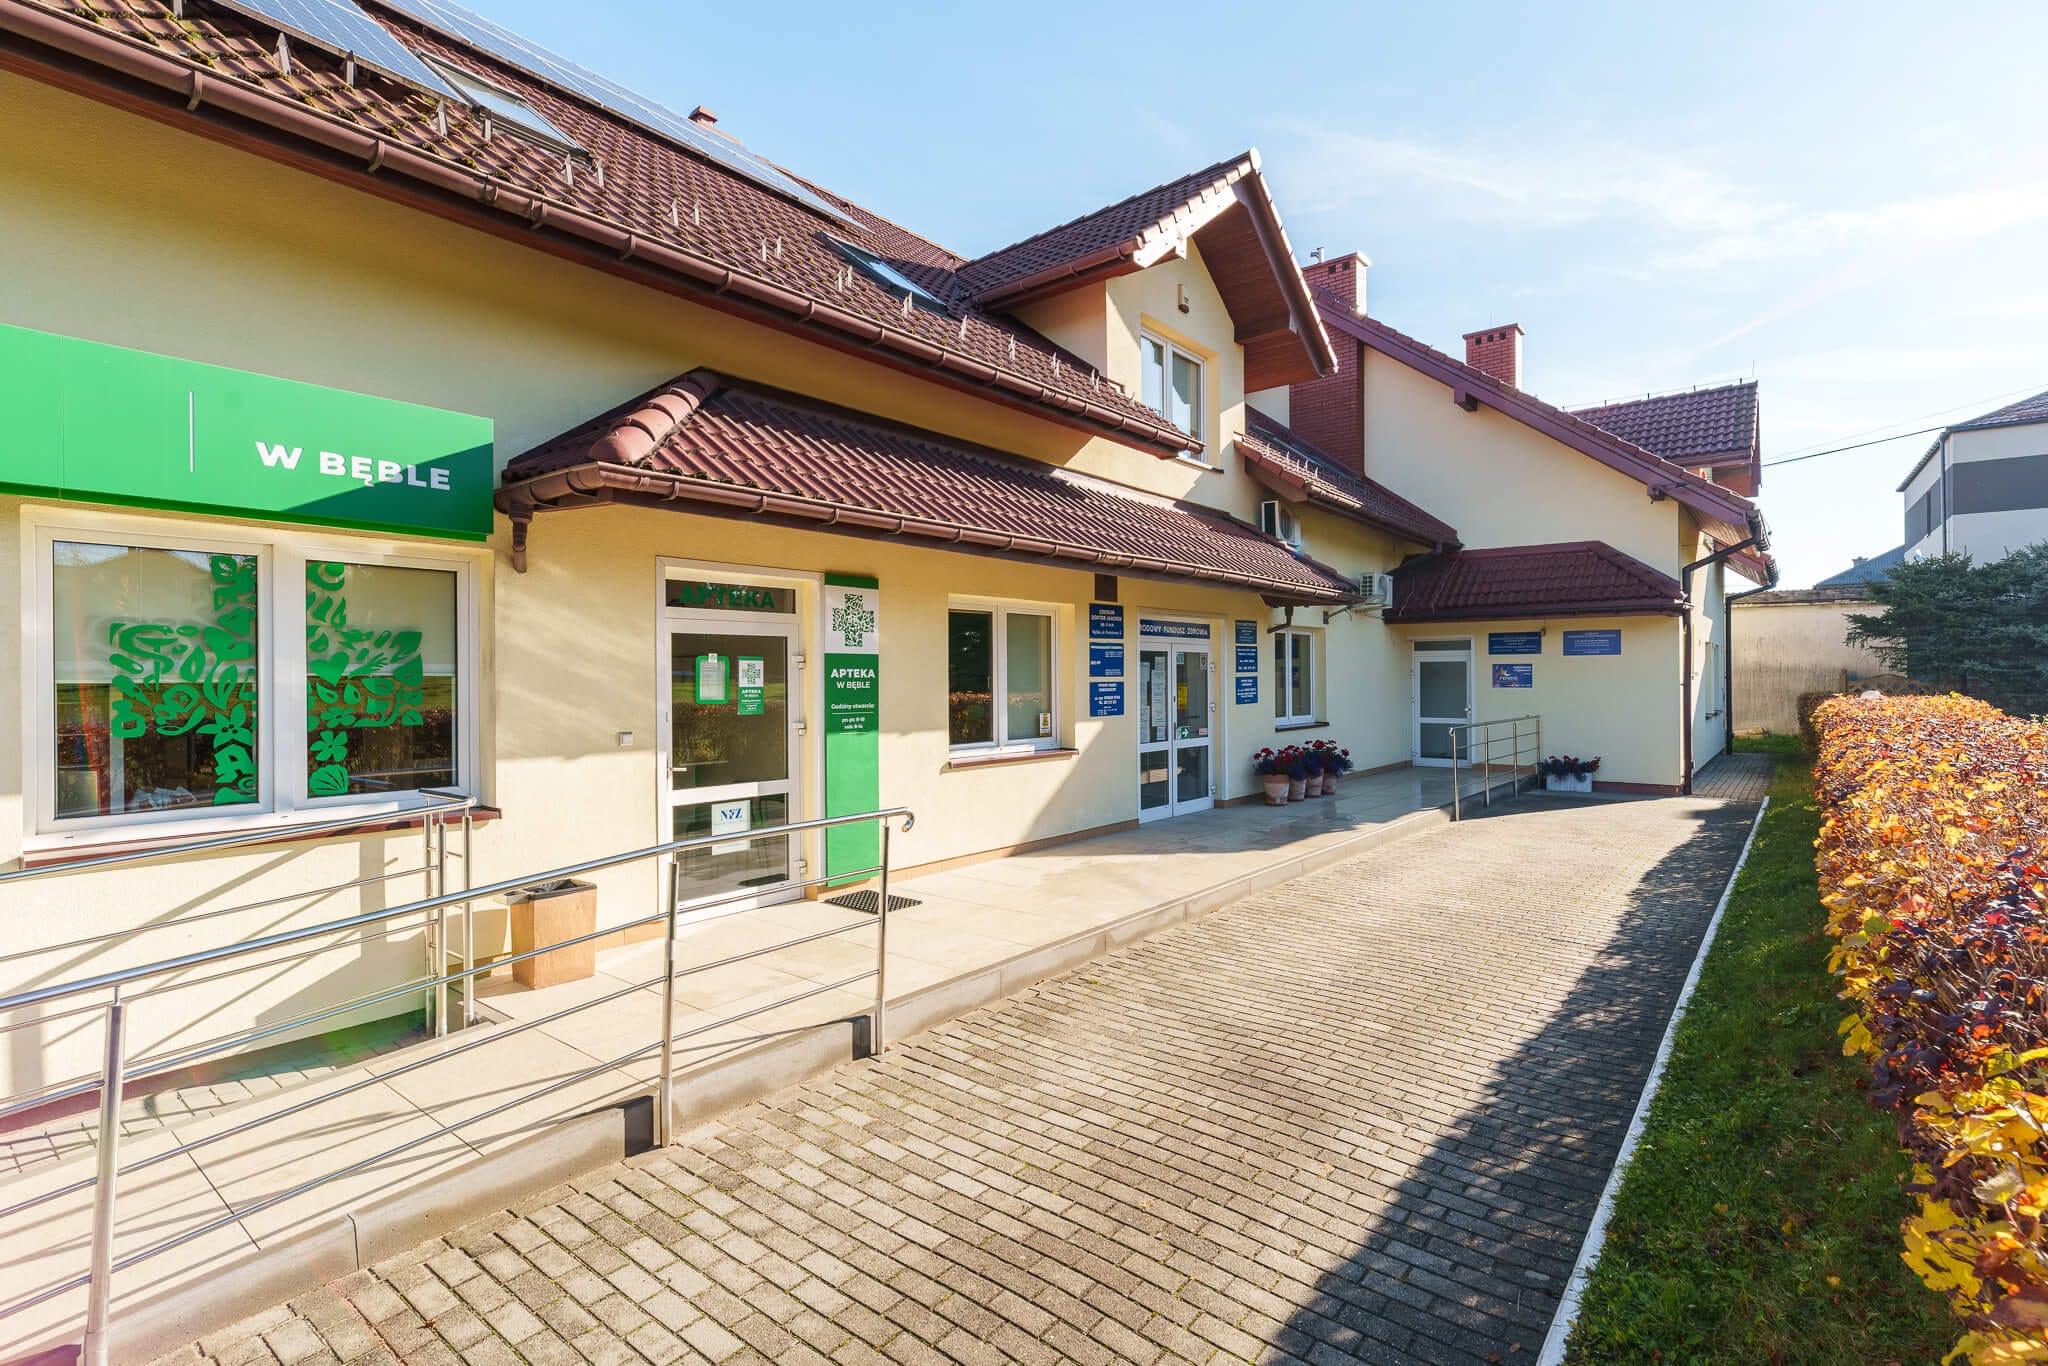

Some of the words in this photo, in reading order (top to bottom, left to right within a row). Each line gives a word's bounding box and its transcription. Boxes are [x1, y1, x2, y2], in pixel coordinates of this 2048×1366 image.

[255, 441, 303, 470] W
[319, 451, 451, 491] BĘBLE
[680, 585, 775, 609] APTEKA
[830, 668, 876, 678] APTEKA
[836, 681, 845, 689] W
[846, 681, 871, 690] BĘBLE
